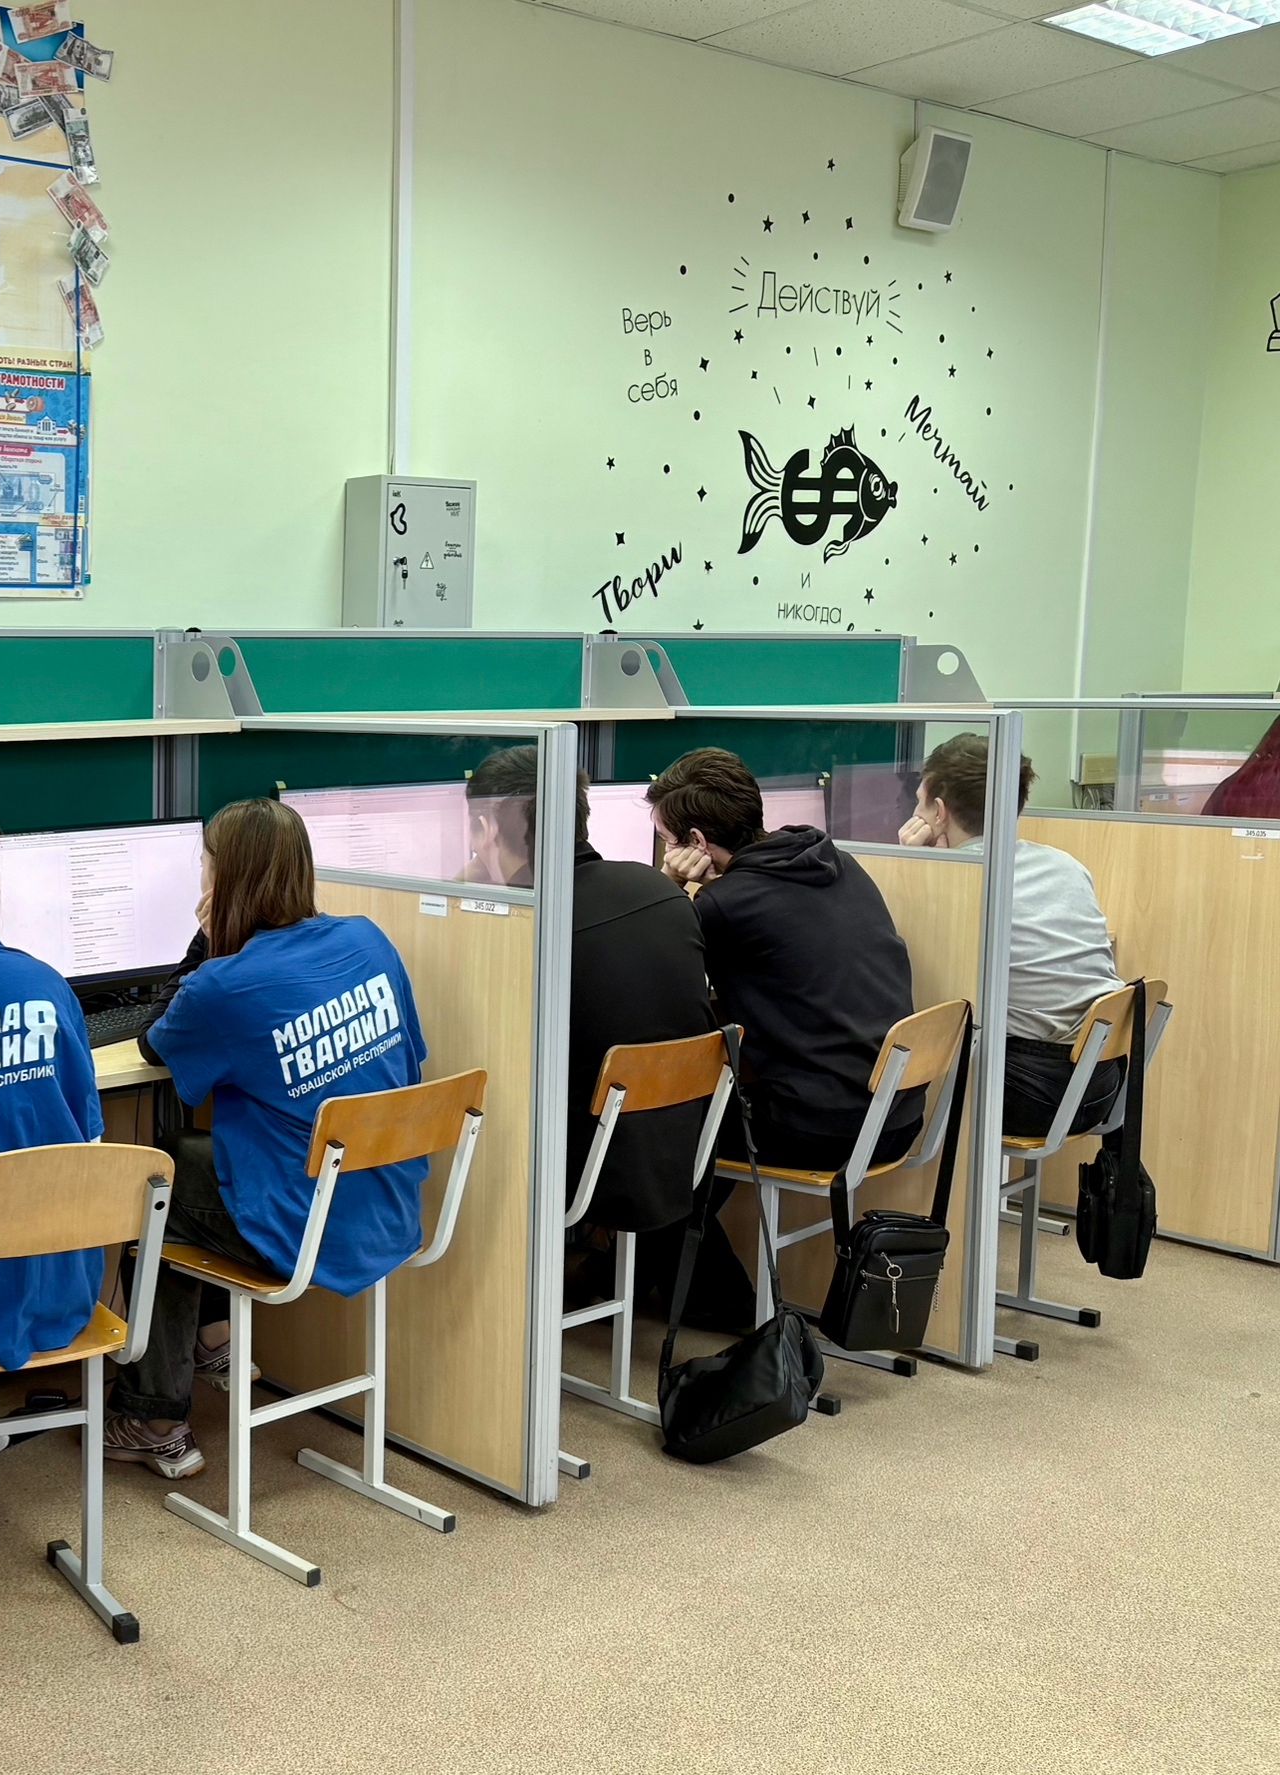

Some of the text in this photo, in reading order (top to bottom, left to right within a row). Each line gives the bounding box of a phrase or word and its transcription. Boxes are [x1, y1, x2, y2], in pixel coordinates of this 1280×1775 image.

[622, 307, 672, 336] Верь
[757, 270, 881, 325] Действуй
[17, 357, 47, 367] РАЗНЫХ
[49, 359, 72, 368] СТРАН
[627, 372, 678, 403] себя
[904, 395, 989, 511] Мечтай
[592, 541, 683, 623] Твори
[777, 602, 842, 625] никогда
[272, 973, 400, 1055] МОЛОДАЯ
[287, 1032, 402, 1099] ЧУВАШСКОЙ РЕСПУБЛИКИ
